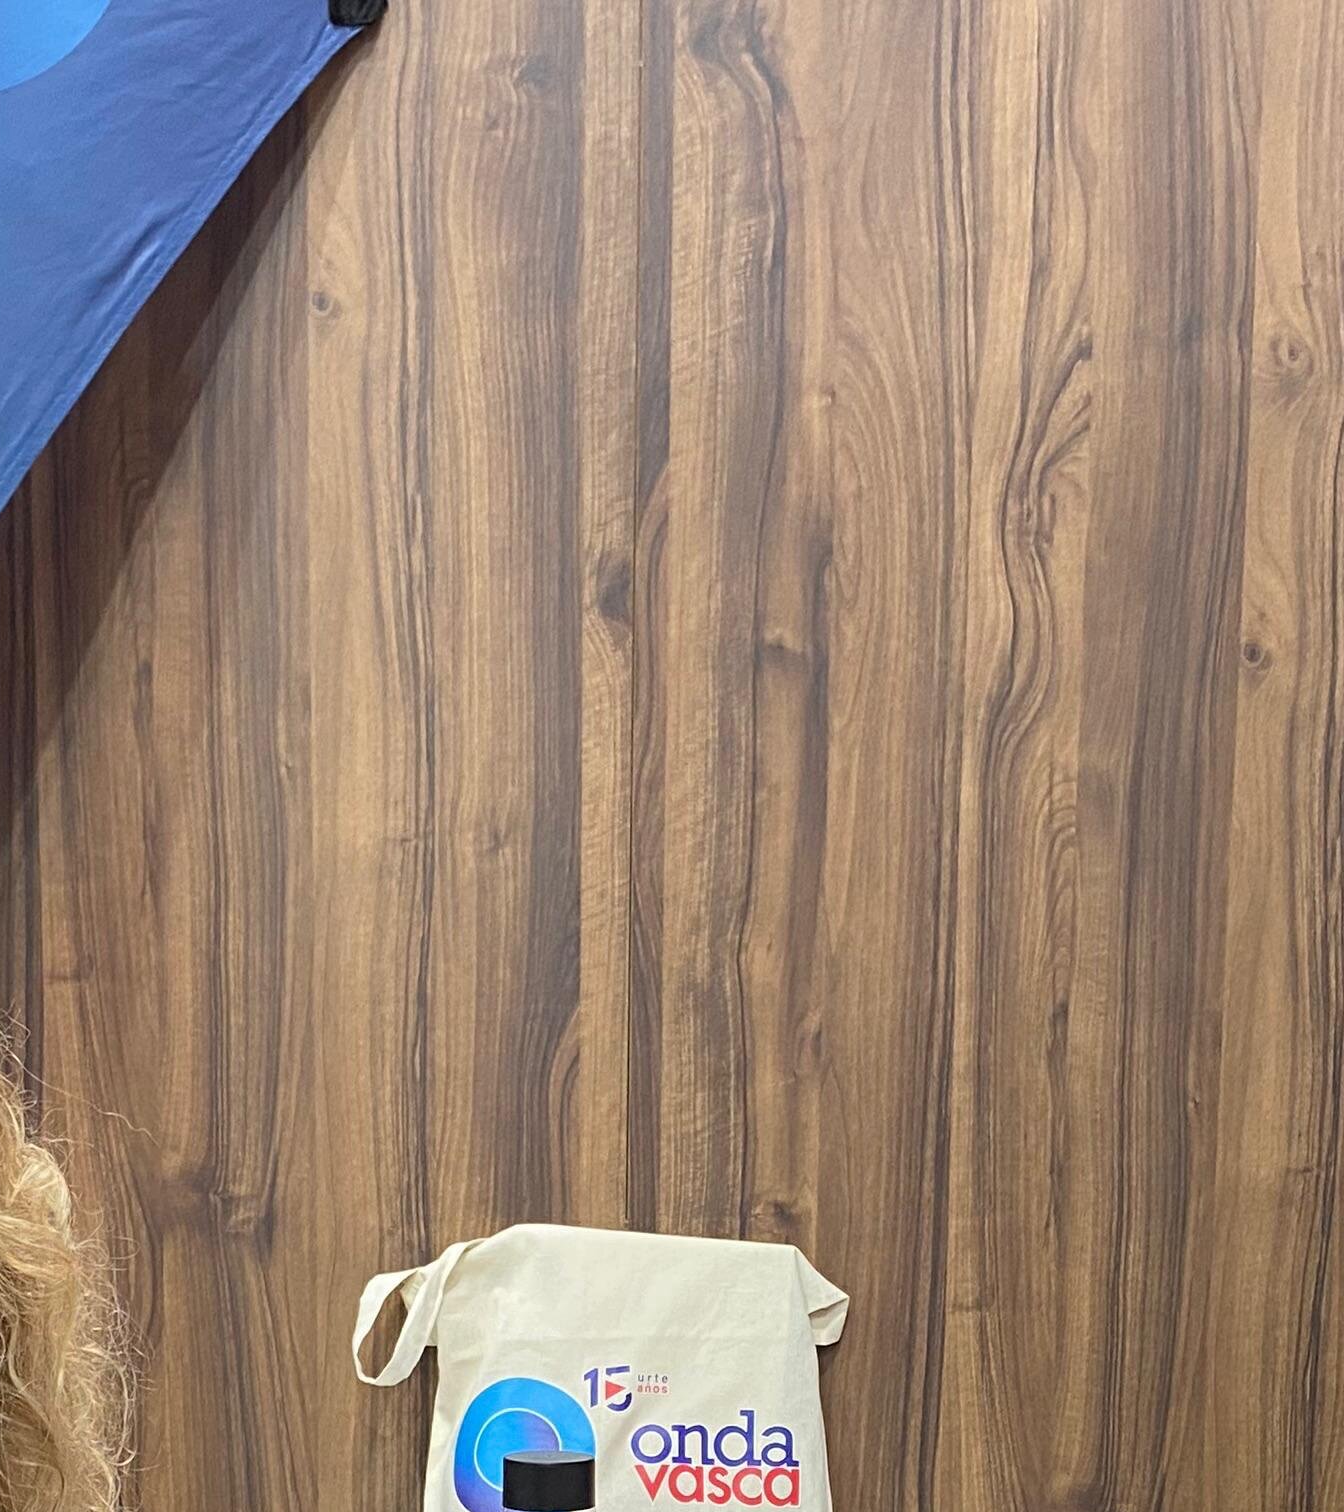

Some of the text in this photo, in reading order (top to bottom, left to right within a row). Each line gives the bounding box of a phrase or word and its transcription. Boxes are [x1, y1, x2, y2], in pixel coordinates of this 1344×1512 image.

[583, 1364, 634, 1413] 15
[636, 1383, 669, 1395] años
[637, 1373, 669, 1384] urte
[630, 1409, 800, 1467] onda
[634, 1463, 801, 1508] vasca
